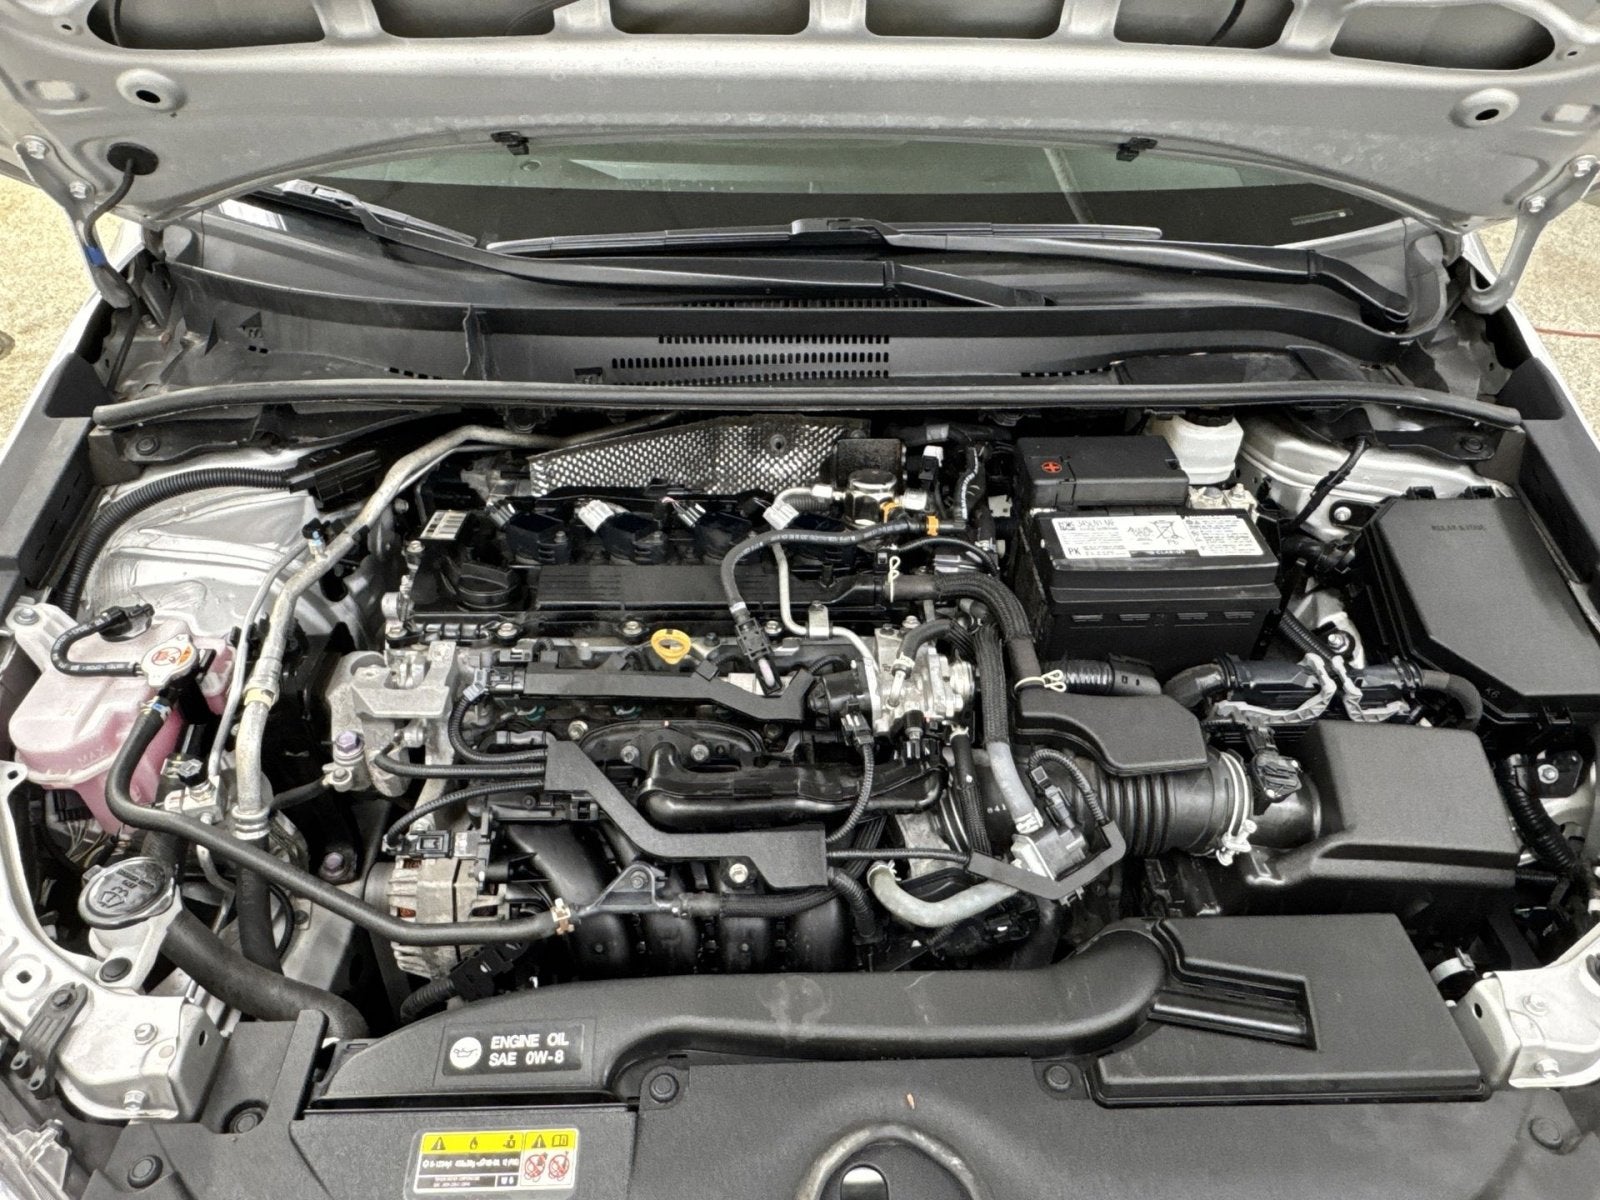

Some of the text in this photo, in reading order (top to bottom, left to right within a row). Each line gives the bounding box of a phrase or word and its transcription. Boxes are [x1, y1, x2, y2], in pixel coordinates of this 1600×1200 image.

[490, 1032, 570, 1050] ENGINE OIL
[488, 1049, 565, 1067] SAE 0W-8
